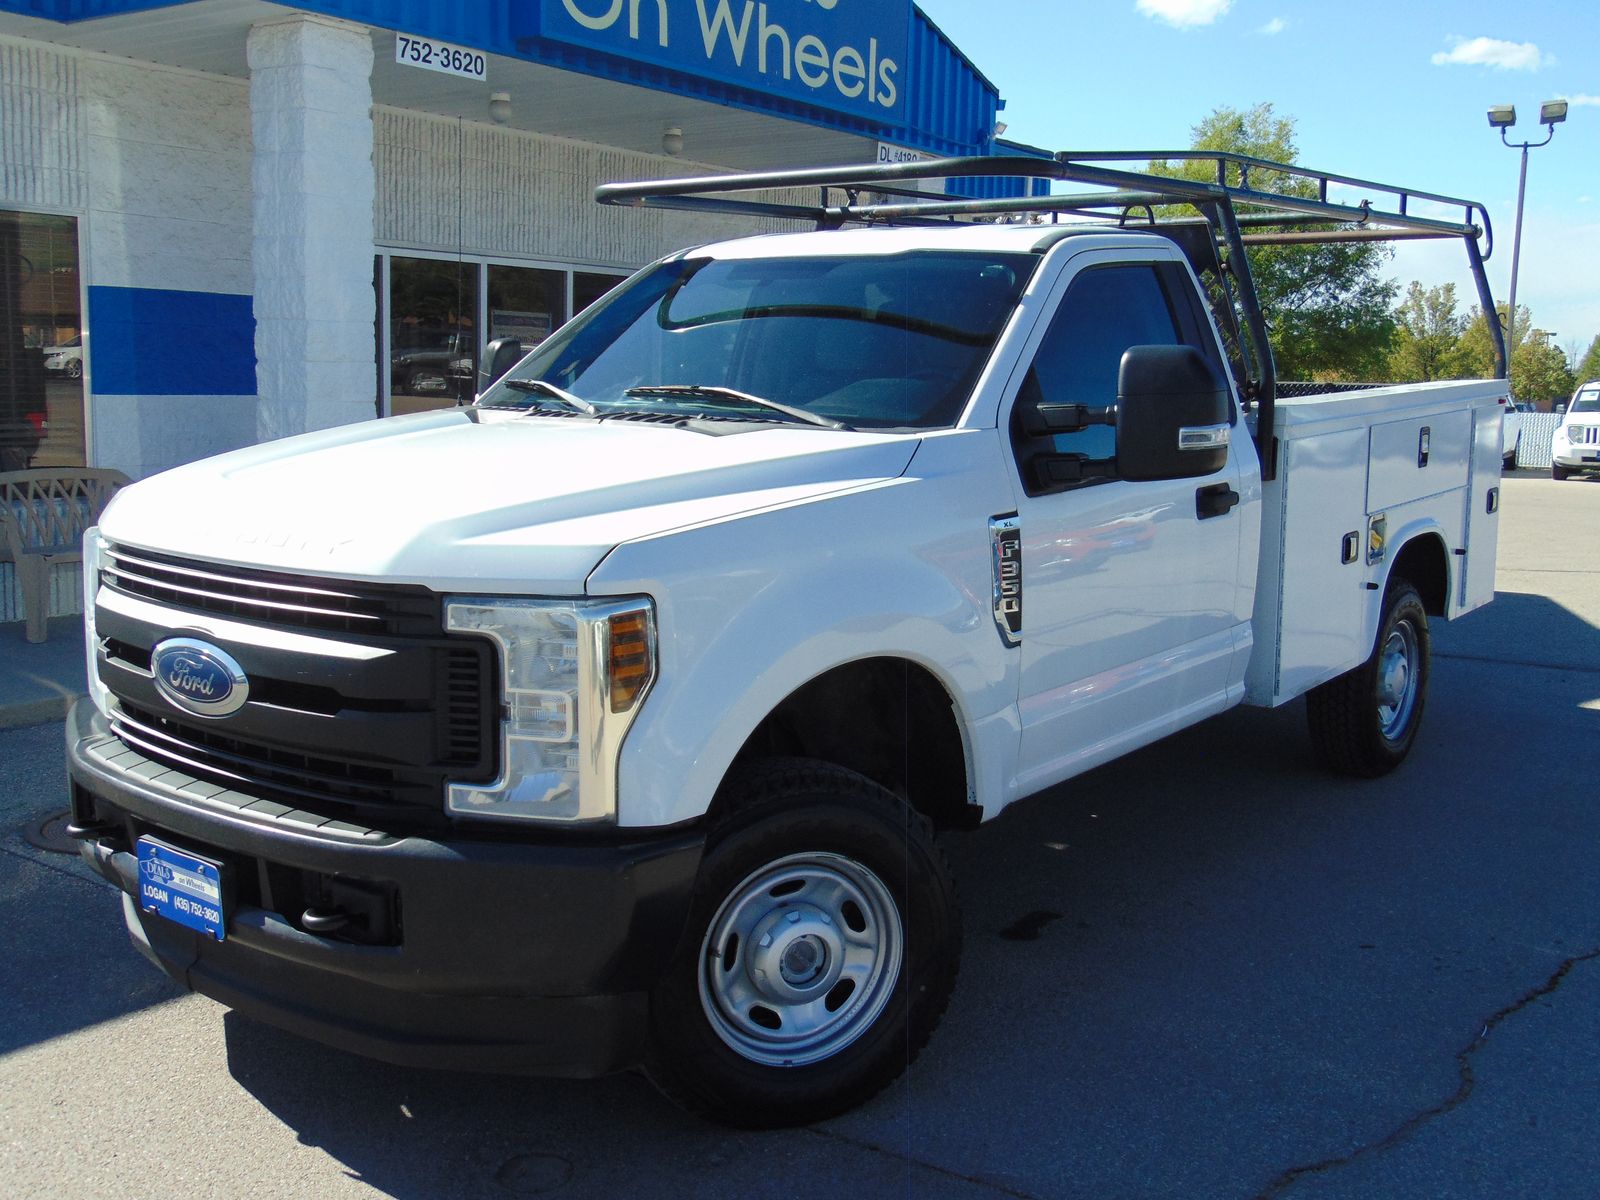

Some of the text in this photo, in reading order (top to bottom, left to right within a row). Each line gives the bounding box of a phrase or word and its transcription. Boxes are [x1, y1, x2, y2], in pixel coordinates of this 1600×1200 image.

[398, 36, 485, 76] 752-3620
[696, 0, 898, 108] Wheels
[879, 146, 892, 162] DL
[1001, 539, 1020, 612] F350
[169, 657, 215, 696] Ford
[143, 884, 220, 924] LOGAN (435) 752-3620
